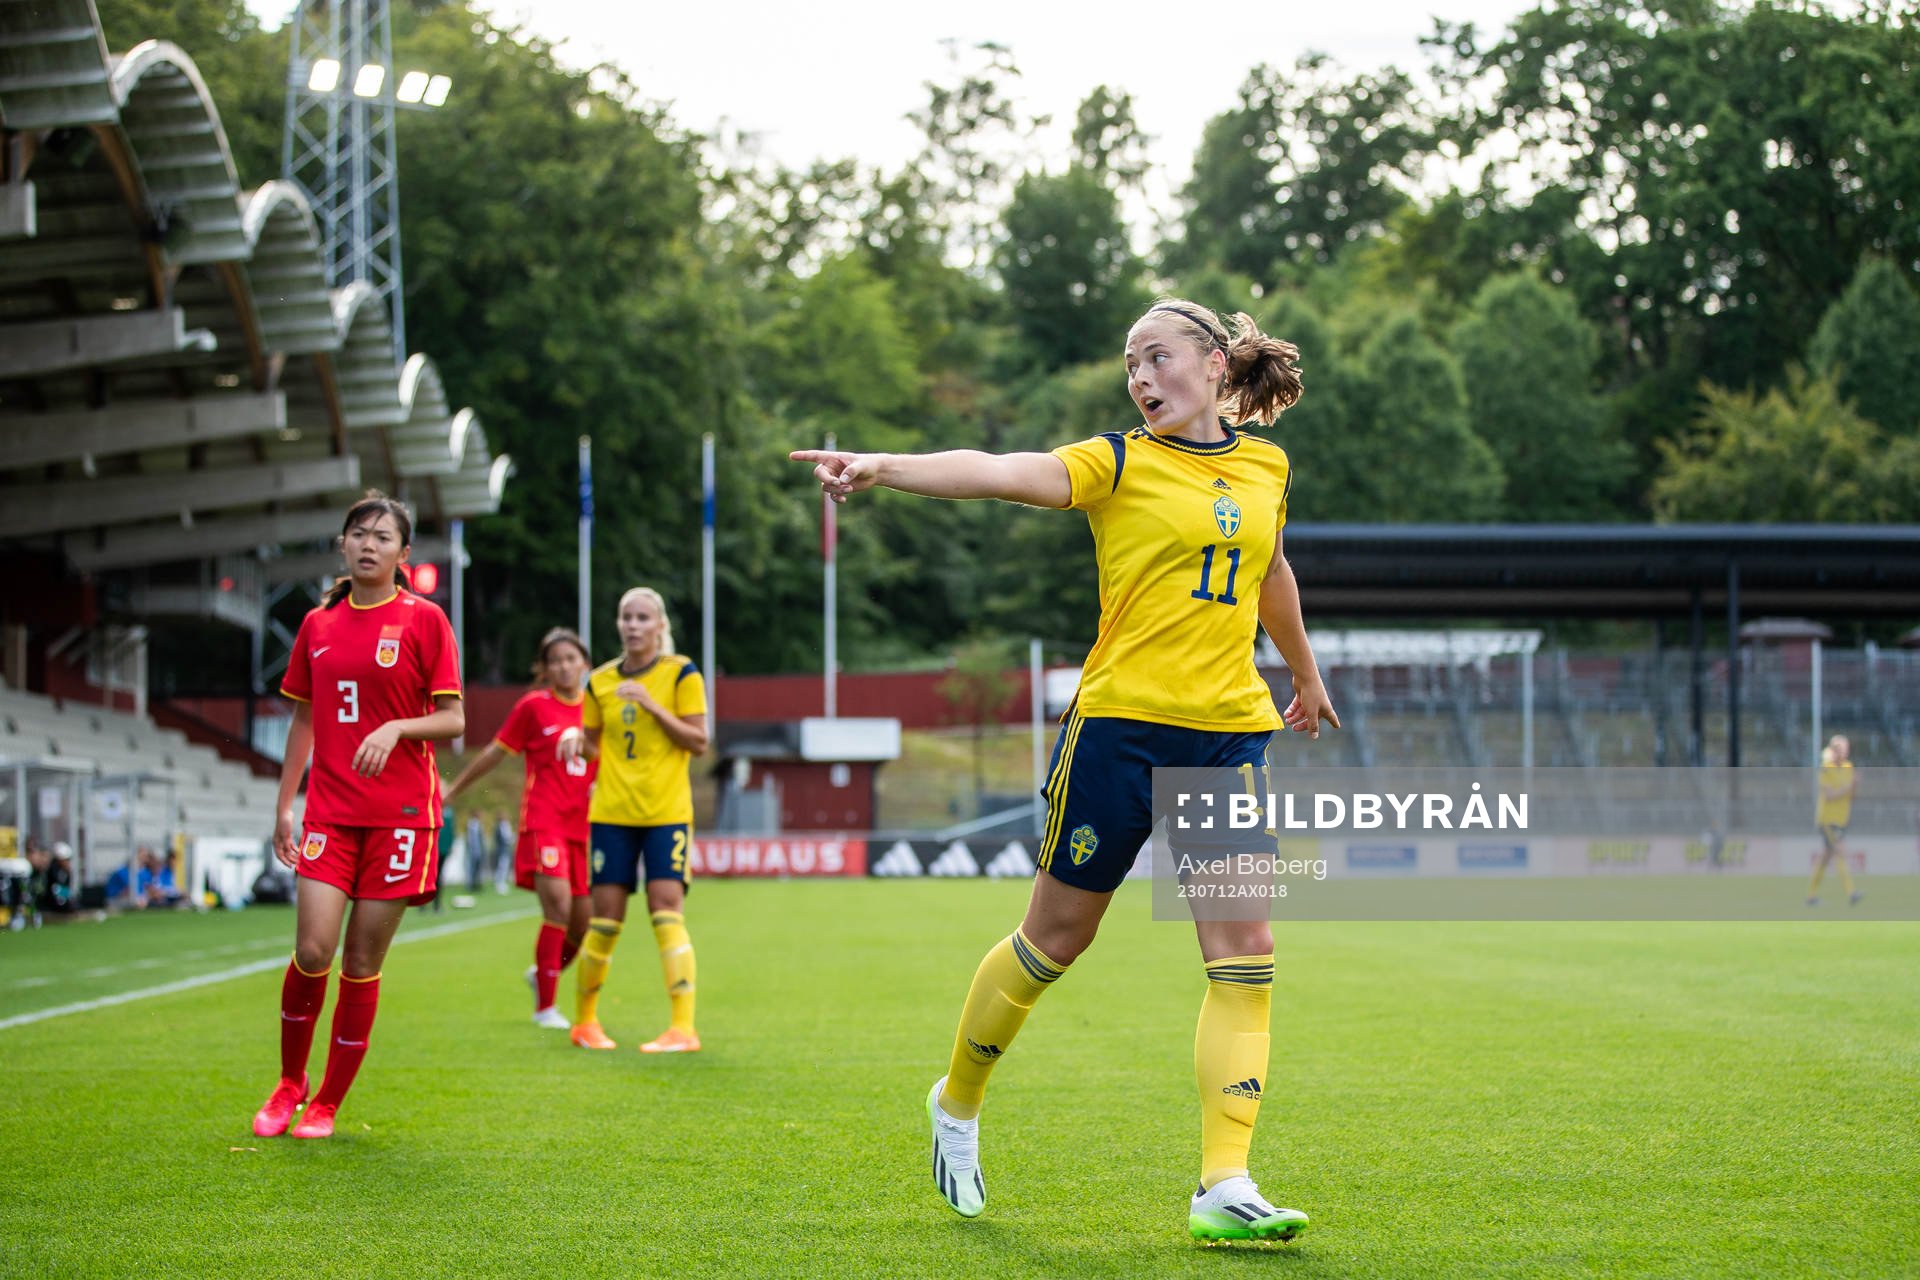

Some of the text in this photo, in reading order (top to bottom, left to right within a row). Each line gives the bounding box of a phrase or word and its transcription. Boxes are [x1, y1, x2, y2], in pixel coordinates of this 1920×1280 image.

[1191, 544, 1241, 606] 11
[337, 680, 359, 723] 3
[624, 730, 637, 760] 2
[389, 828, 415, 871] 3
[671, 830, 687, 863] 2
[691, 841, 845, 874] AUHAUS
